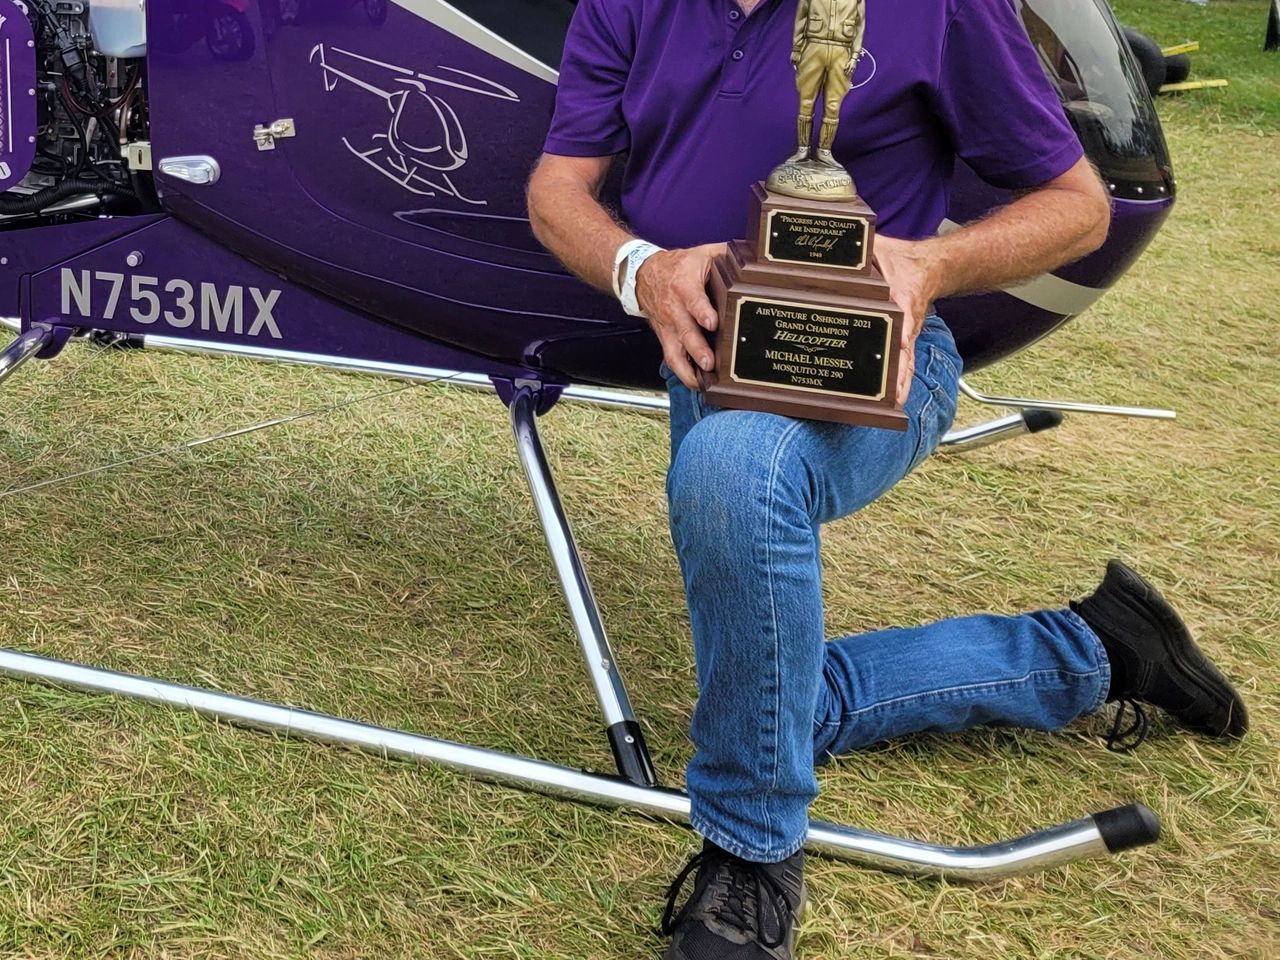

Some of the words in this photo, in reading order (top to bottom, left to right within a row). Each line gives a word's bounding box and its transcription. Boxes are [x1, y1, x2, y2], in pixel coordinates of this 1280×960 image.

[61, 267, 283, 339] N753MX
[853, 318, 872, 329] 2021
[765, 349, 812, 365] MICHAEL
[814, 355, 854, 370] MESSEX
[772, 362, 817, 375] MOSQUITO
[818, 368, 830, 378] XE
[830, 370, 844, 379] 290
[791, 375, 823, 387] N753MX
